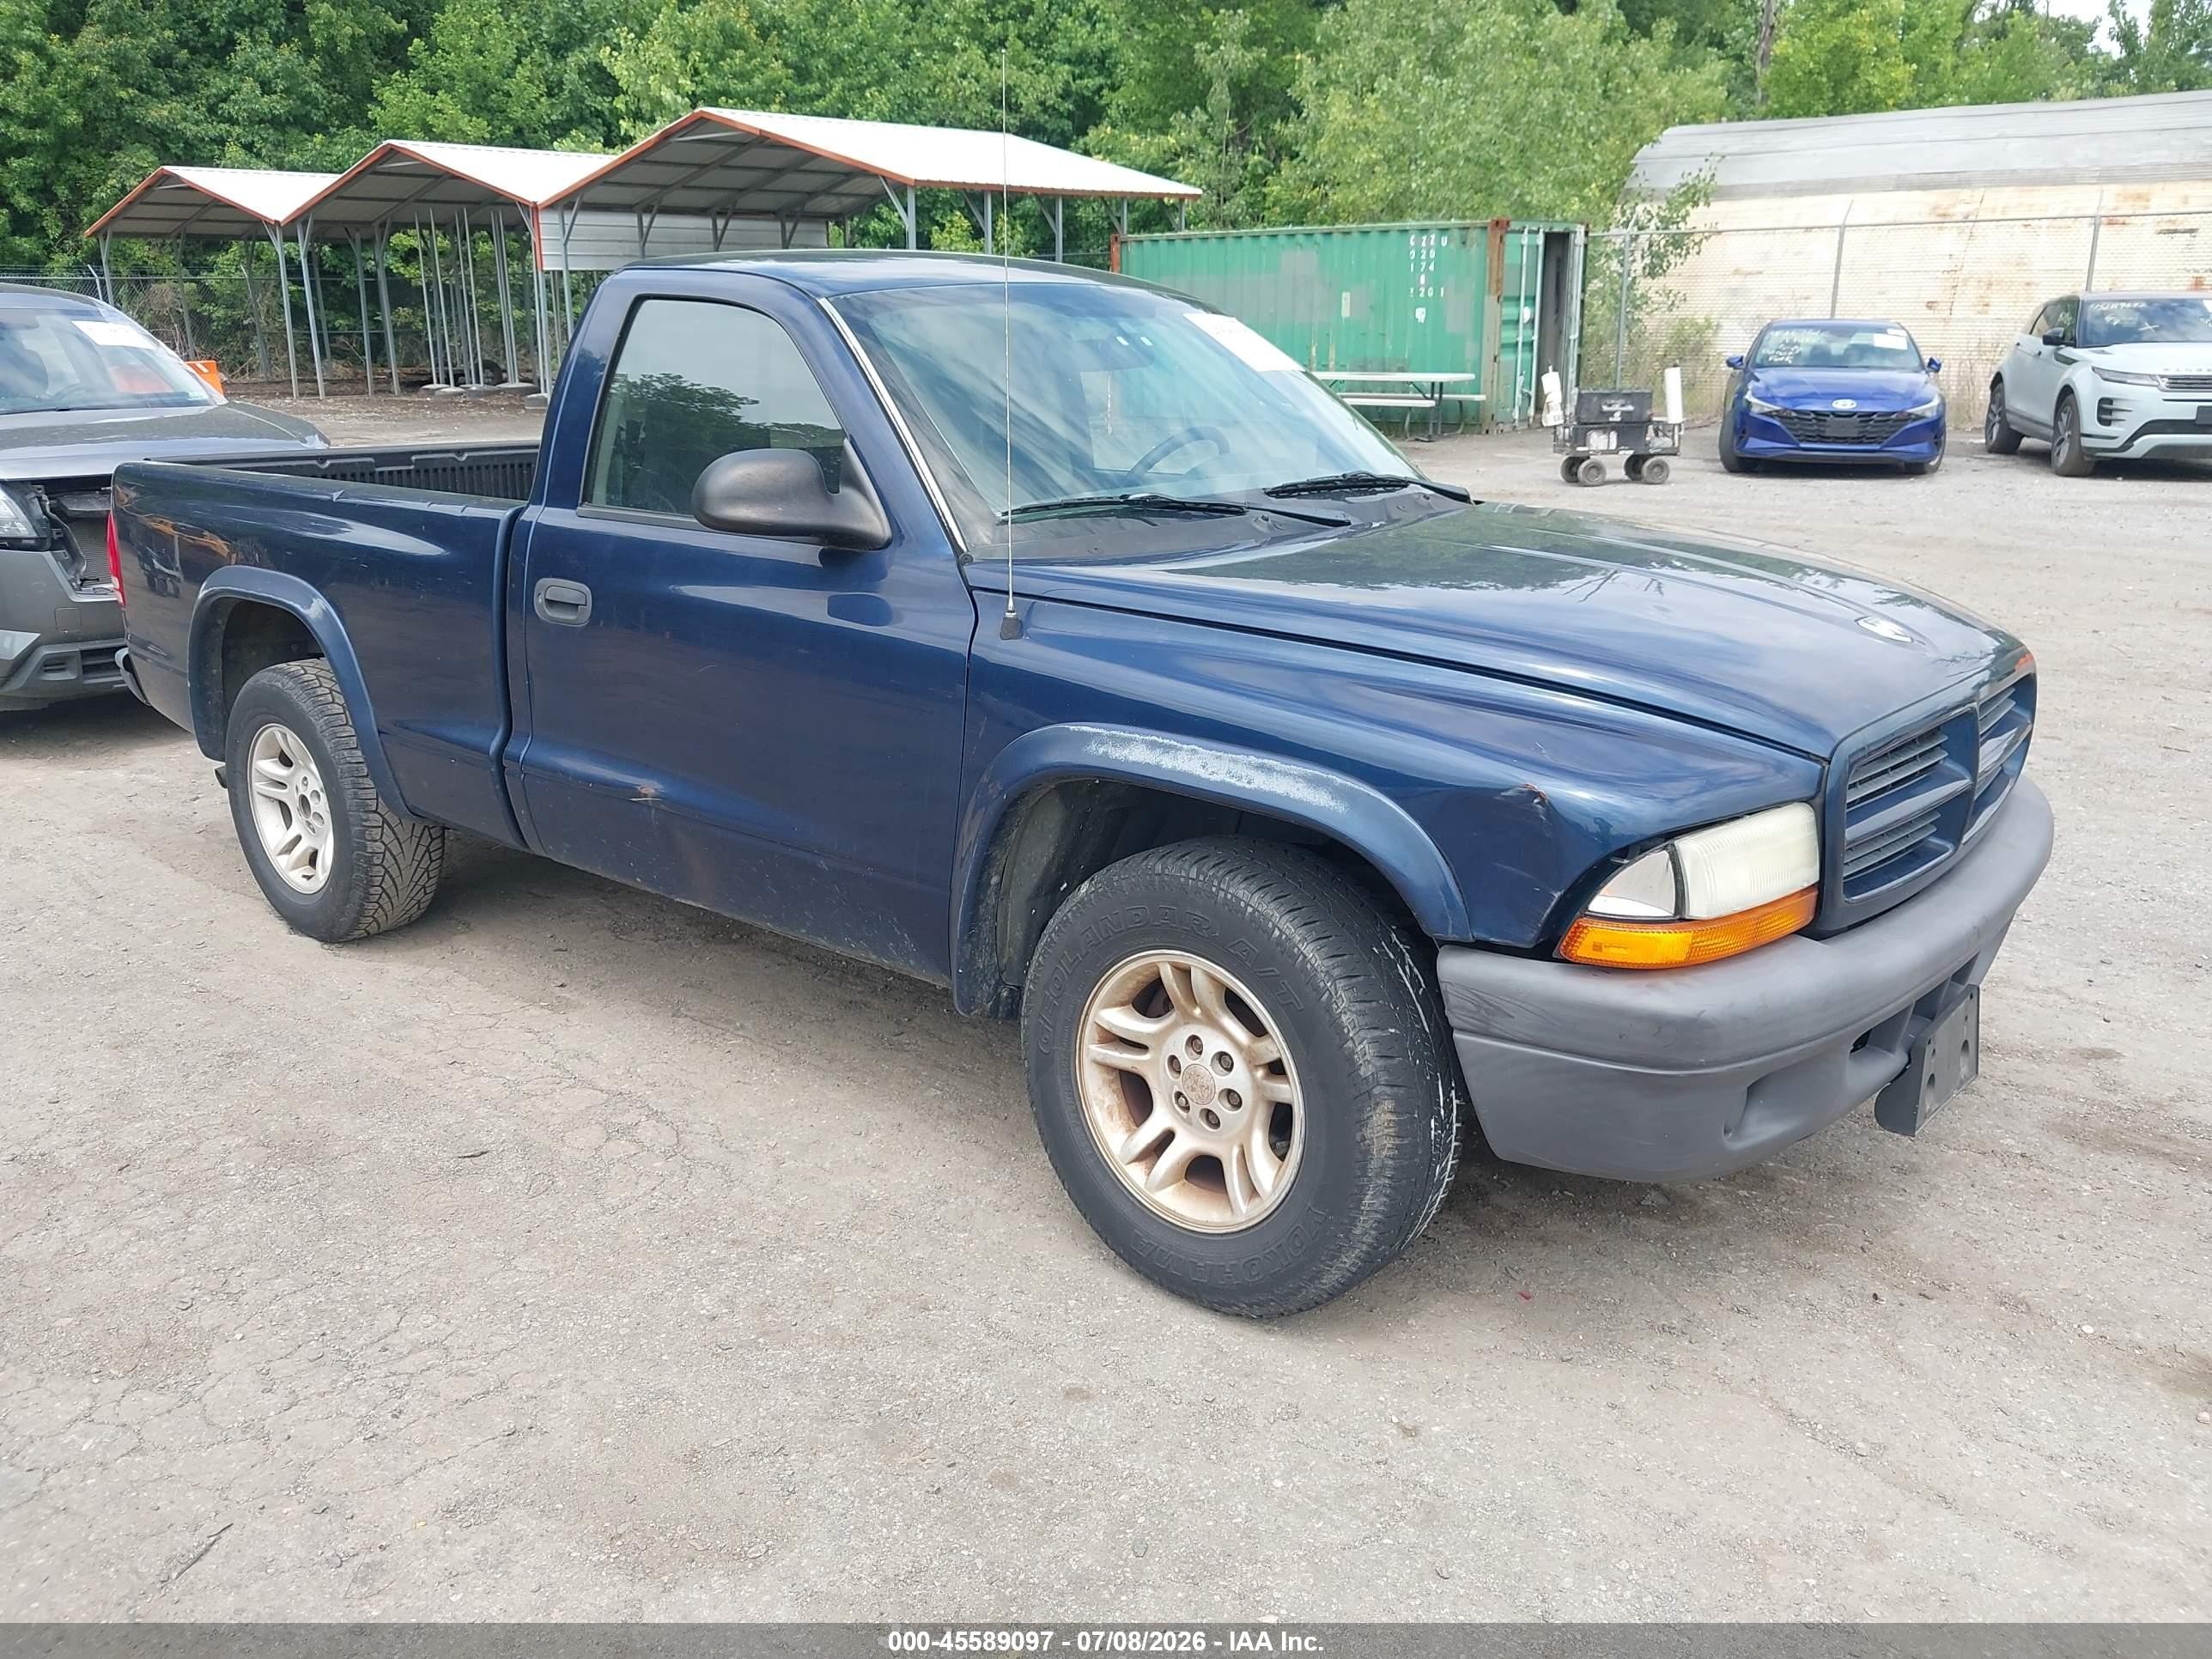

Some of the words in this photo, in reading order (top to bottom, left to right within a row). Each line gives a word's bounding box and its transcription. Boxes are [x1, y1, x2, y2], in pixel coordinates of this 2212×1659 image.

[1410, 260, 1435, 272] 174
[1224, 937, 1304, 1012] A/T
[1130, 1201, 1328, 1285] YOKOHAMA
